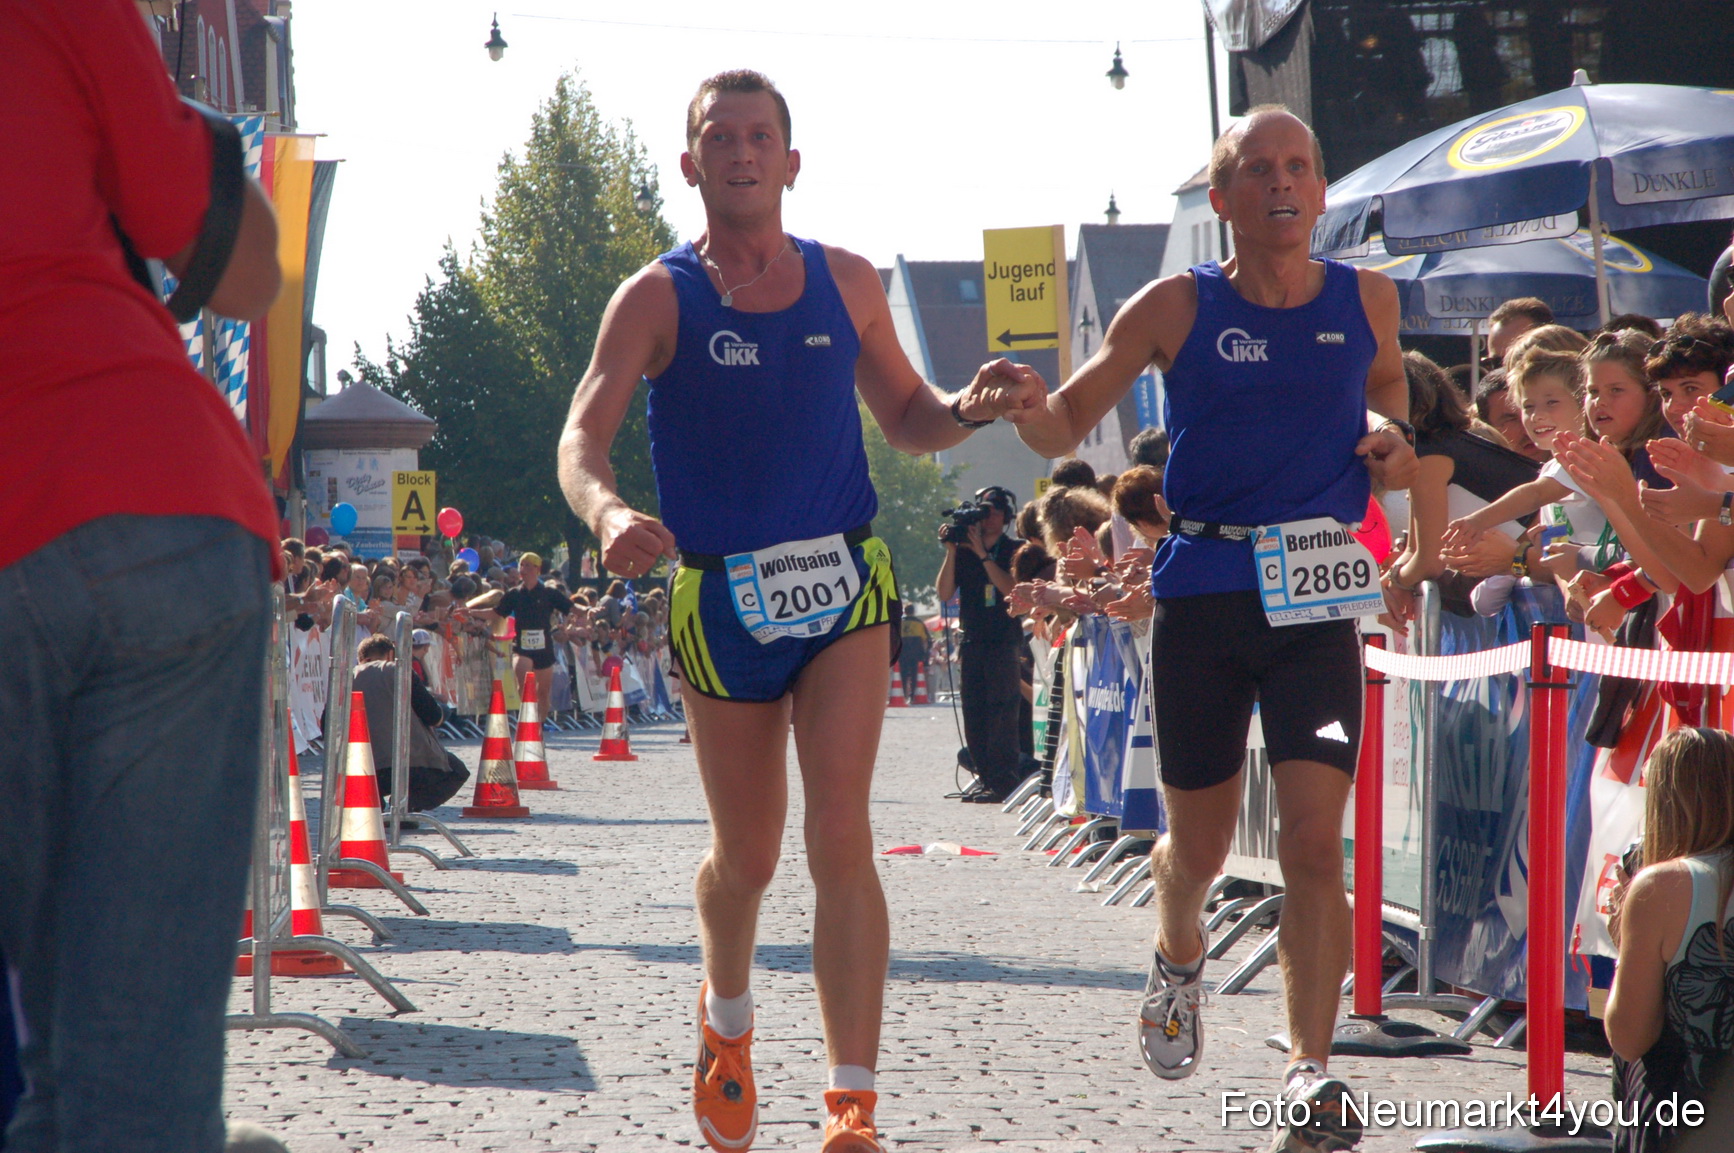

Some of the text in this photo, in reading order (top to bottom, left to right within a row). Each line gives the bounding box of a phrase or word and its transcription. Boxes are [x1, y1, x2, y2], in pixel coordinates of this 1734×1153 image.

[1633, 168, 1716, 194] DUNKLE
[988, 259, 1056, 283] Jugend
[1010, 282, 1045, 302] lauf
[1440, 295, 1504, 313] DUNKL
[397, 473, 432, 486] Block
[401, 490, 426, 521] A
[760, 551, 842, 580] Wolfgang
[1265, 558, 1371, 597] C 2869
[741, 575, 851, 620] C 2001
[1340, 599, 1384, 612] PFLEIDERER
[821, 615, 840, 627] PFLE
